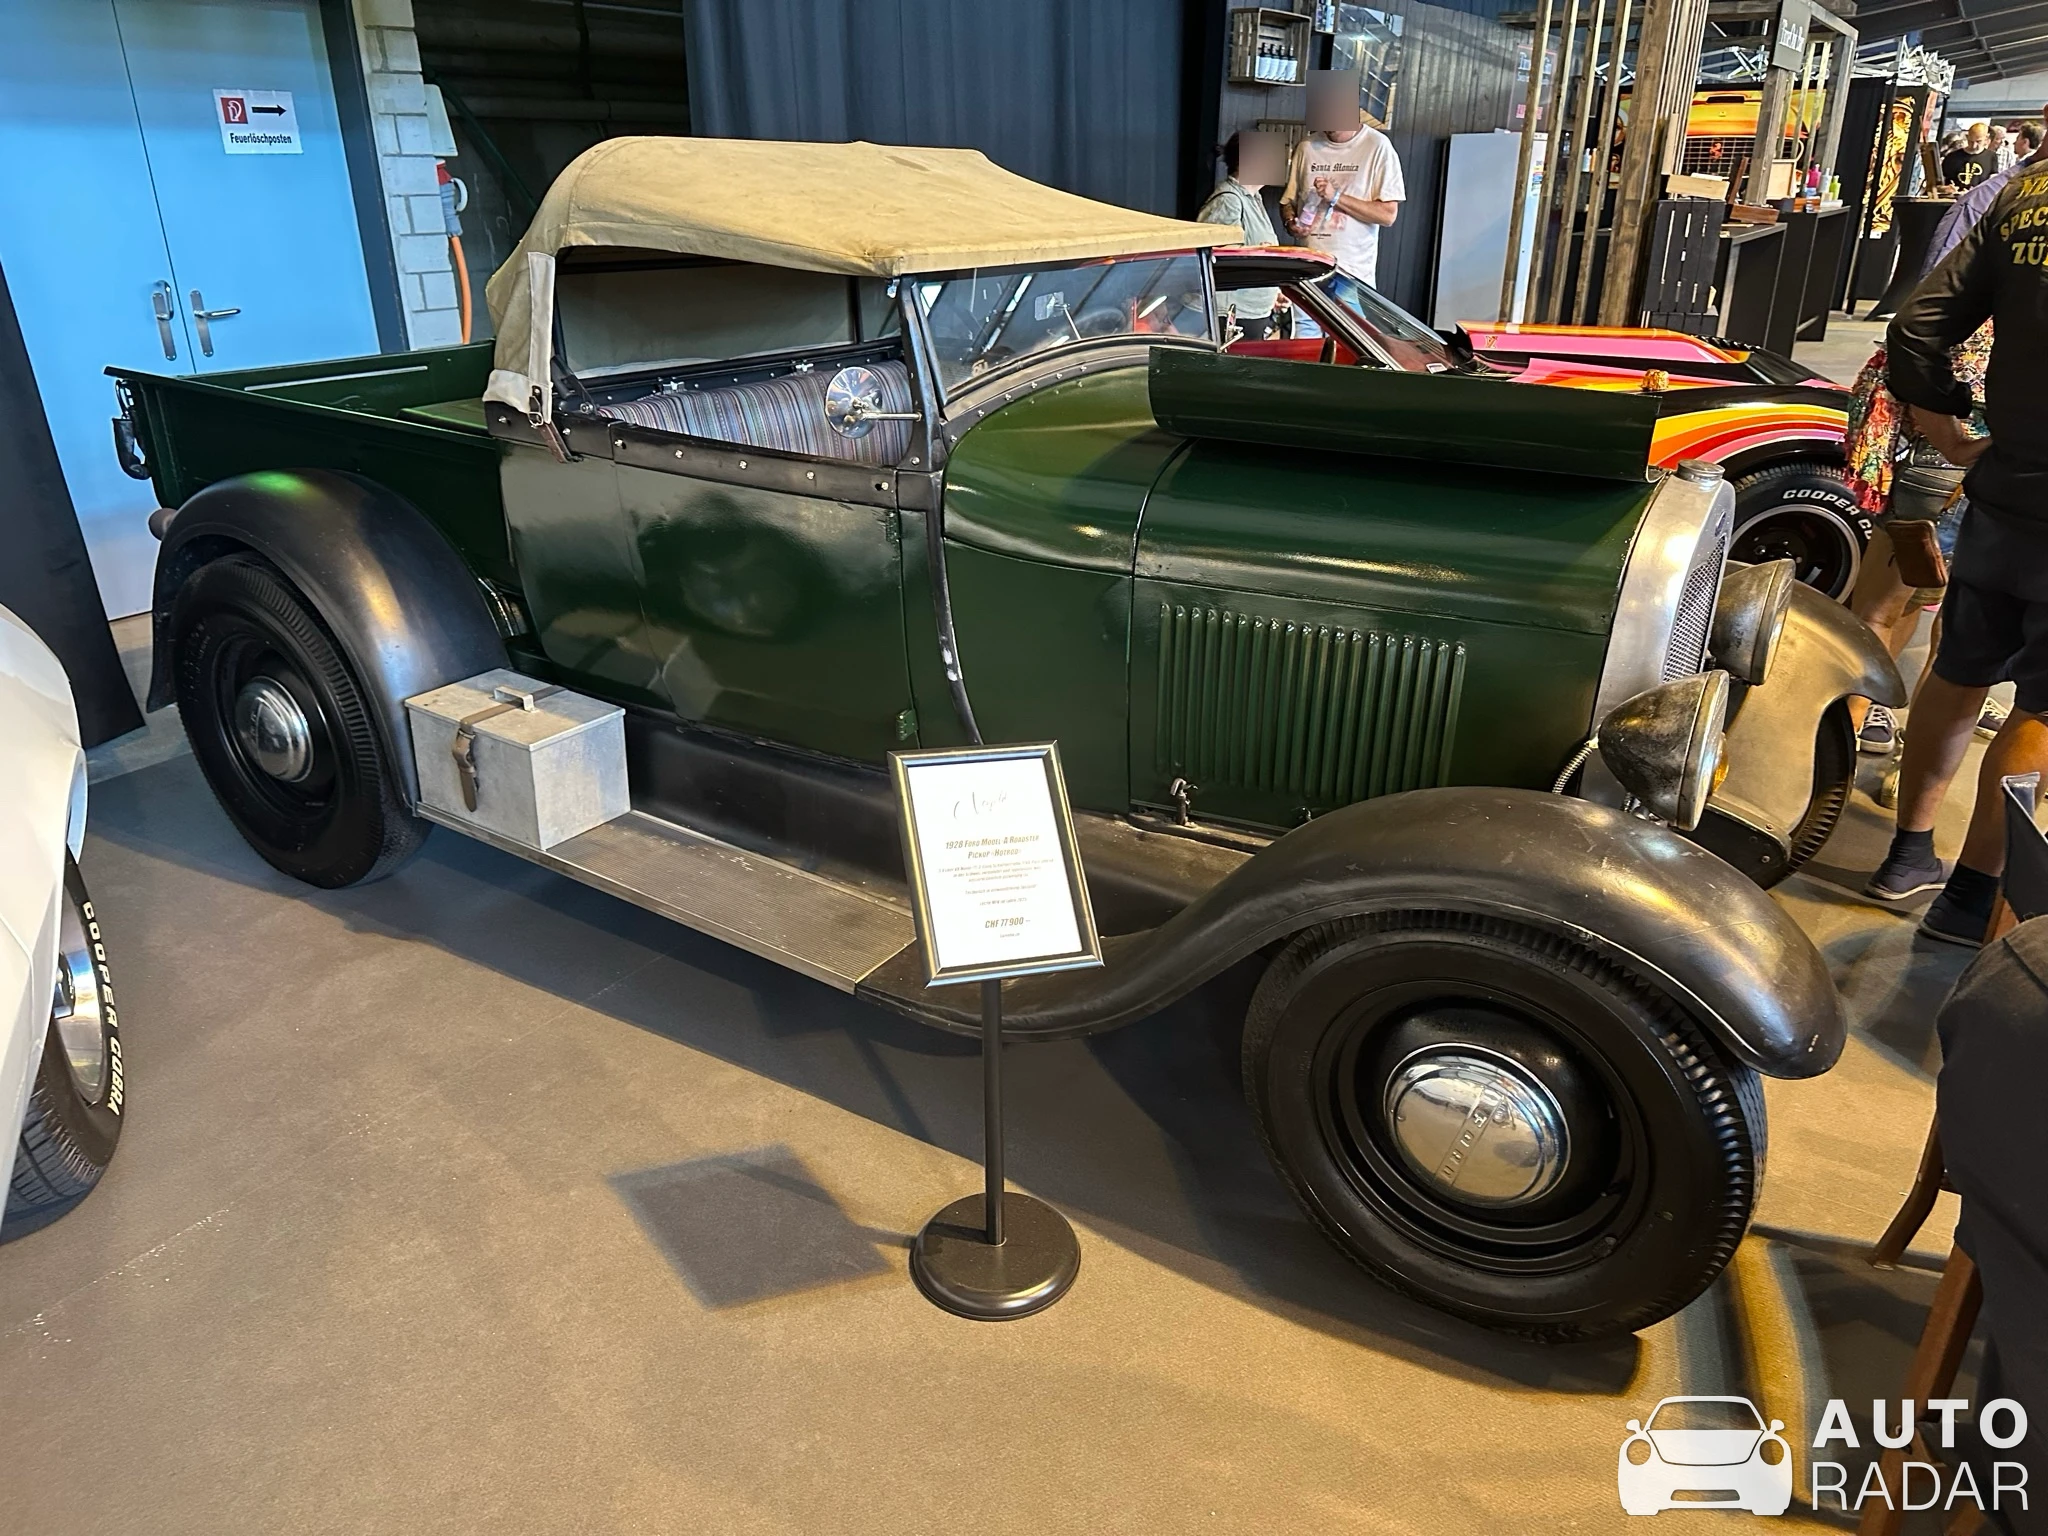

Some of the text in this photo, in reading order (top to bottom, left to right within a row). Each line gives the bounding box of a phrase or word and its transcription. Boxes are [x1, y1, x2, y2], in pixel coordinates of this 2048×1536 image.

[229, 132, 292, 146] Feuerlöschposten
[1311, 163, 1359, 172] Santa Monica
[2000, 206, 2048, 242] SPEC
[1783, 489, 1860, 516] COOPER
[945, 840, 963, 850] 1928
[985, 919, 1000, 929] CHF
[82, 901, 125, 1116] COOPER COBRA
